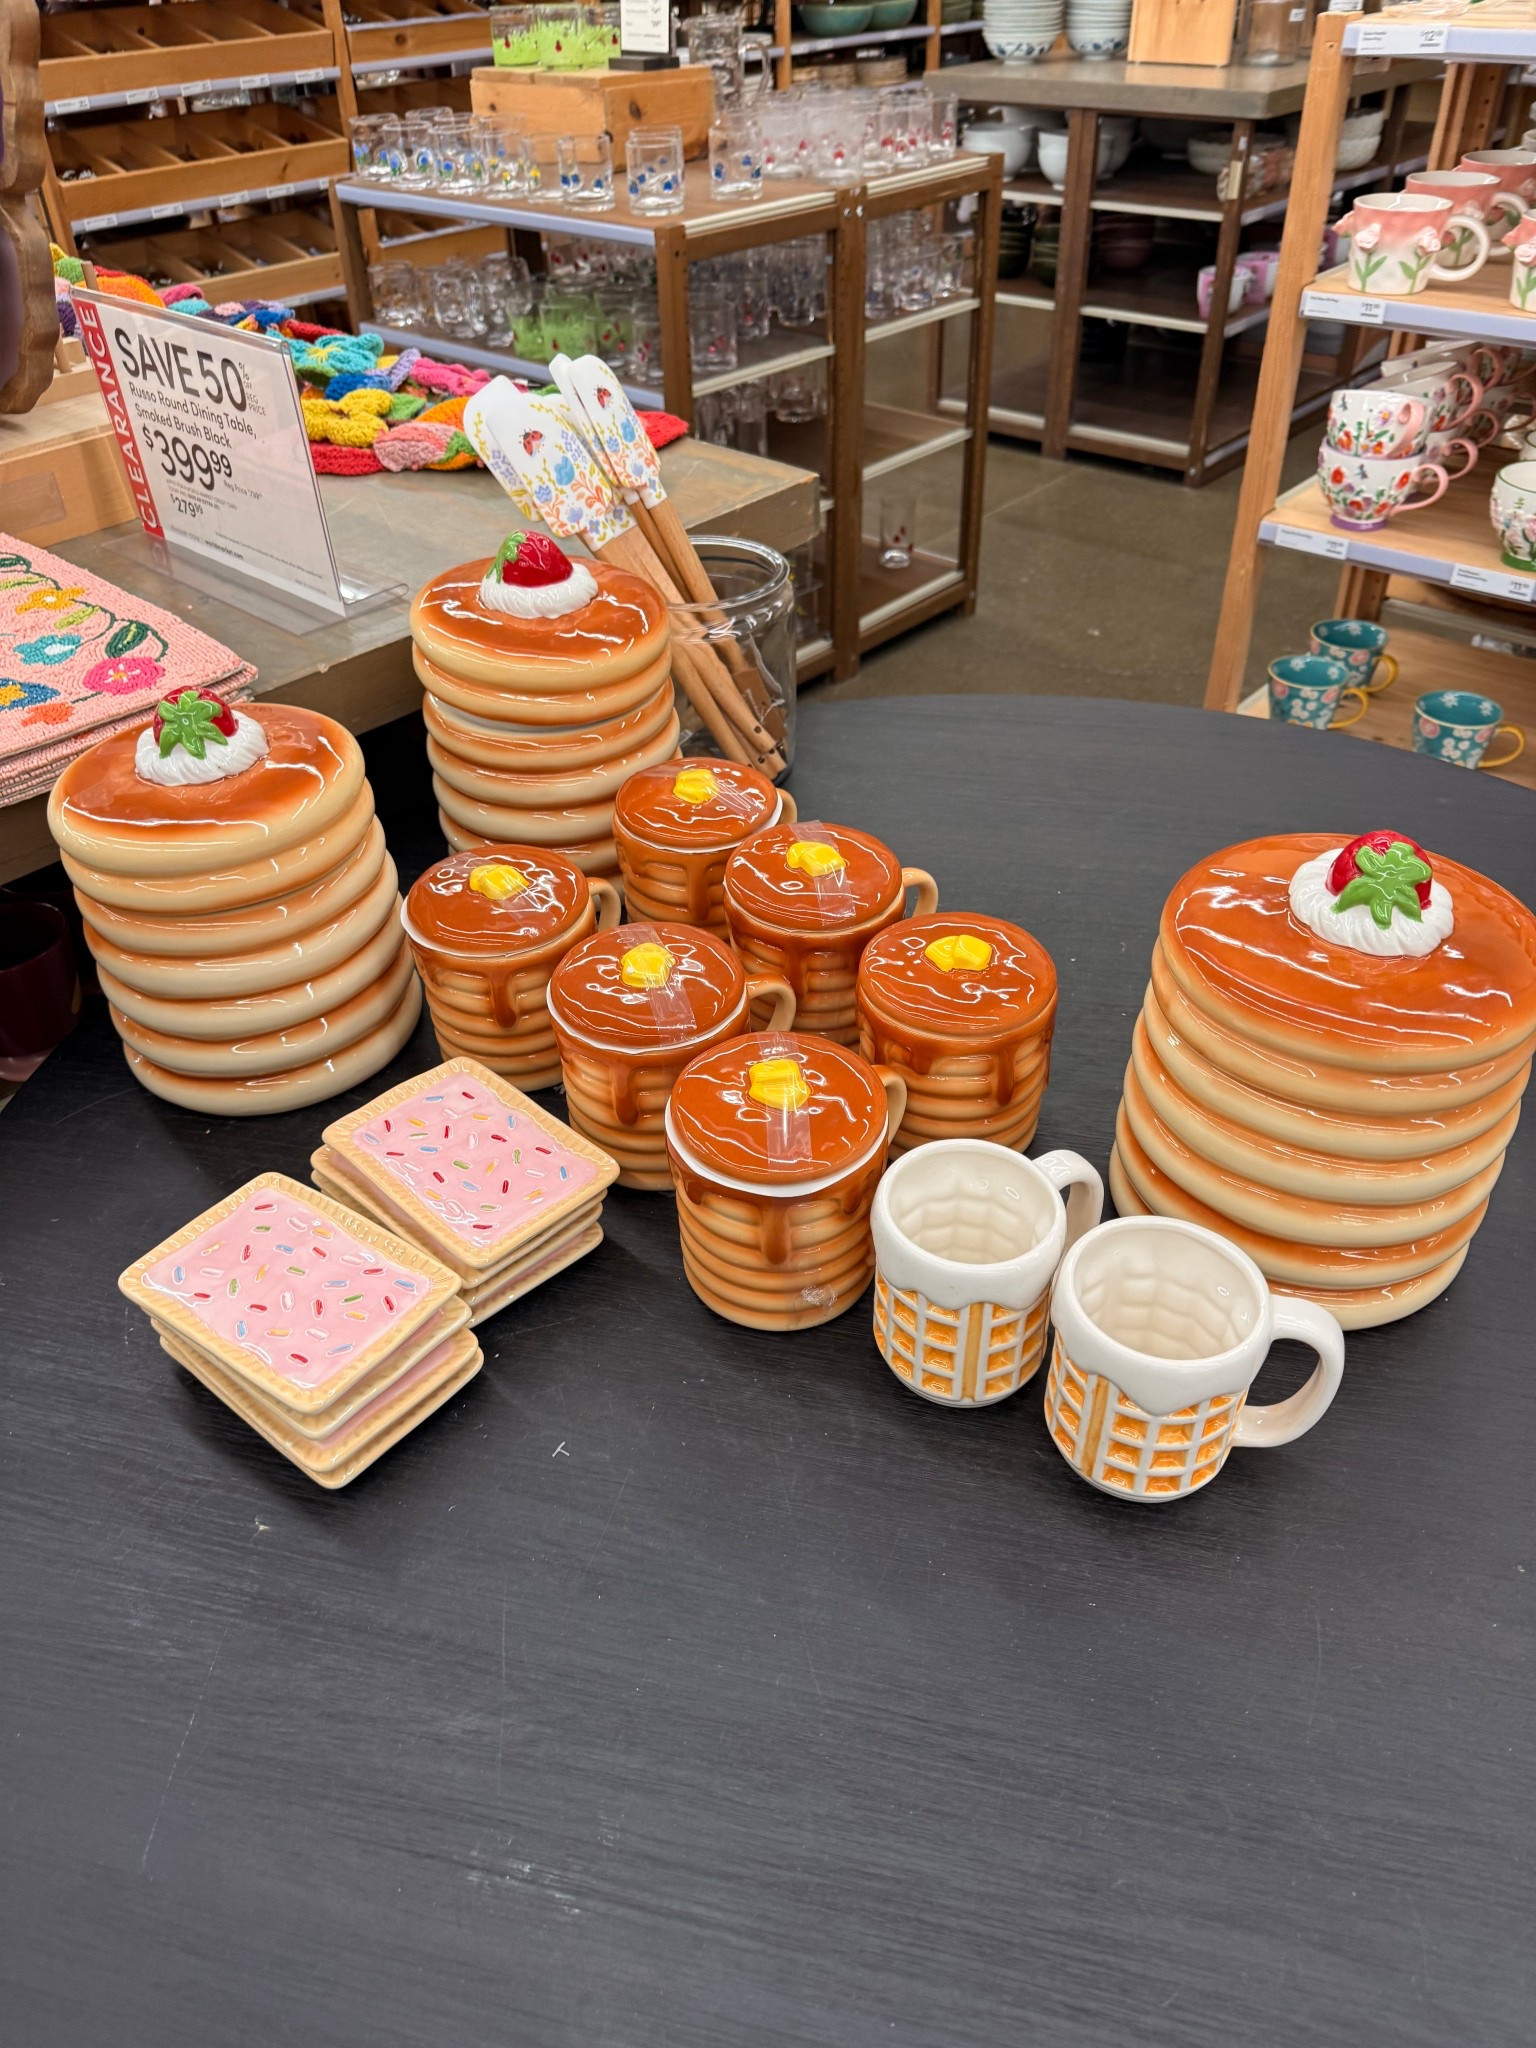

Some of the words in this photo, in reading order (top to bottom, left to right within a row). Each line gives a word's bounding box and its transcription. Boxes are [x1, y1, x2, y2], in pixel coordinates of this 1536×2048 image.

[114, 327, 200, 398] SAVE
[79, 306, 158, 528] CLEARANCE
[128, 381, 157, 403] Russo
[158, 391, 189, 414] Round
[191, 401, 223, 429] Dining
[223, 412, 257, 439] Table,
[134, 403, 173, 428] Smoked
[173, 415, 203, 439] Brush
[204, 427, 232, 449] Black
